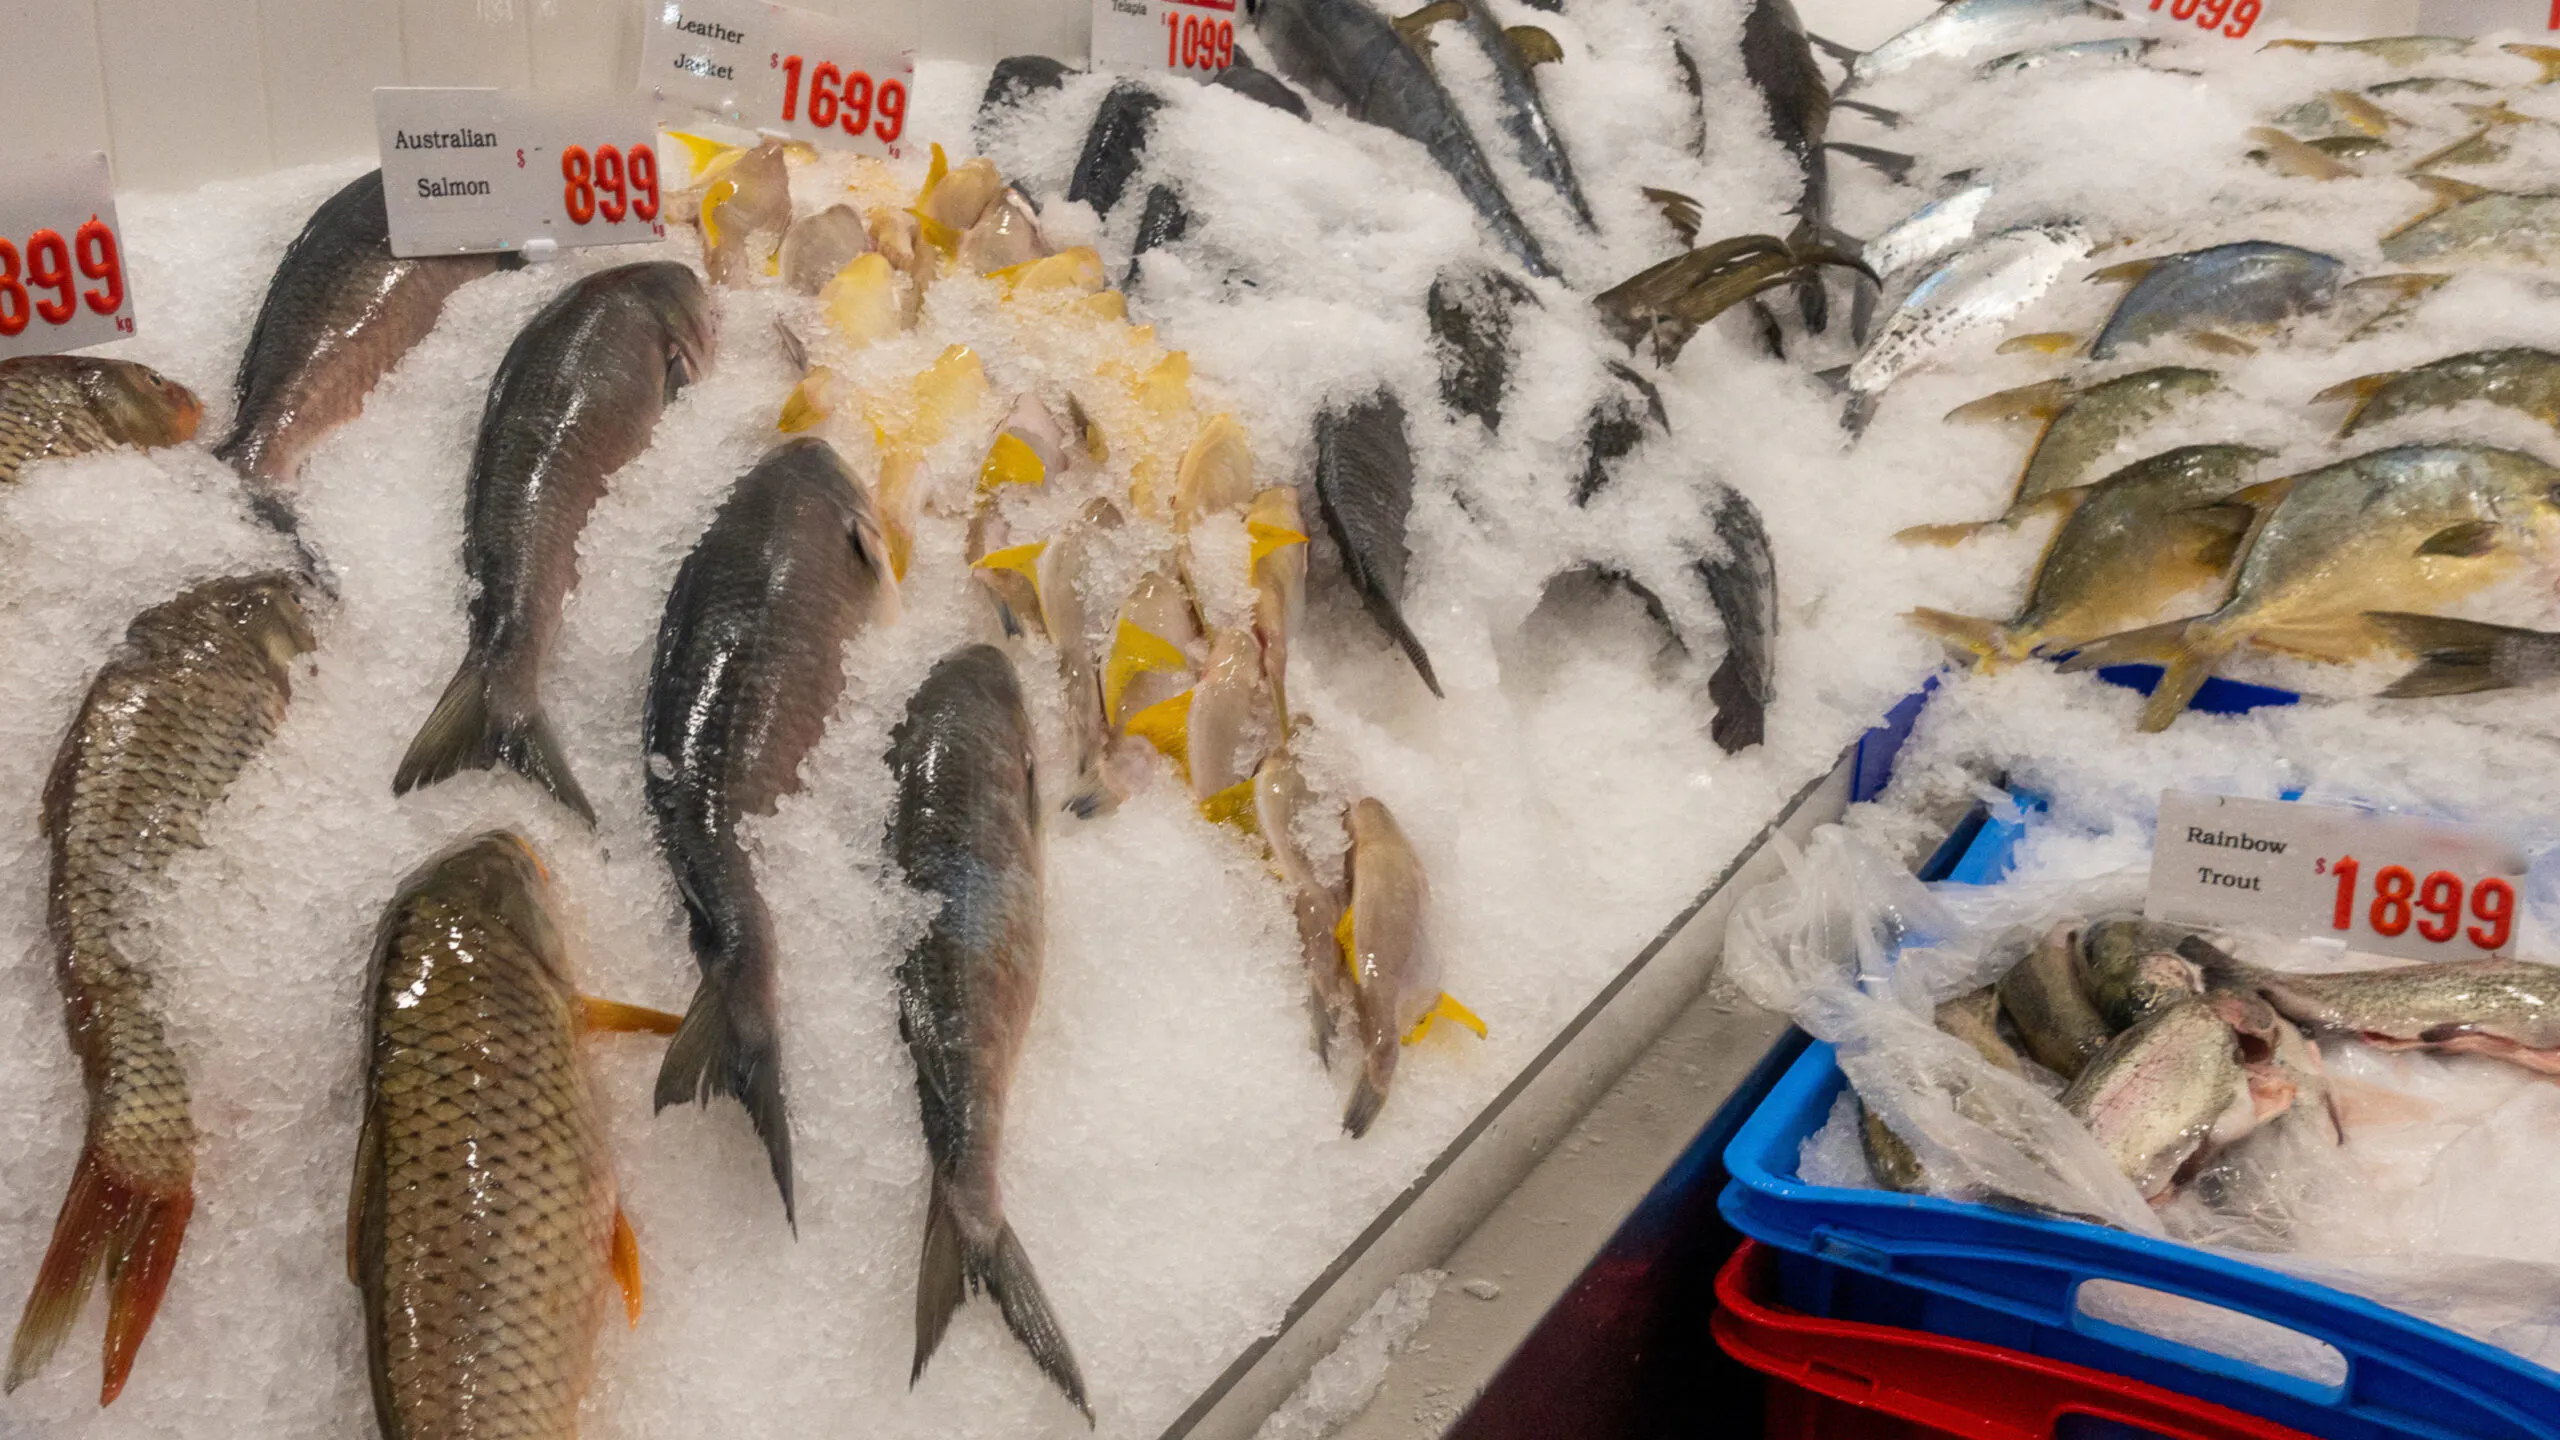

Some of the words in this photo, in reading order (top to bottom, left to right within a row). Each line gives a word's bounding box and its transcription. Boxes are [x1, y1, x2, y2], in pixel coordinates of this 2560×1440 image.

[676, 14, 745, 44] Leather
[395, 129, 498, 150] Australian
[417, 178, 491, 198] Salmon
[115, 316, 134, 333] kg
[2186, 826, 2288, 855] Rainbow
[2198, 866, 2261, 892] Trout
